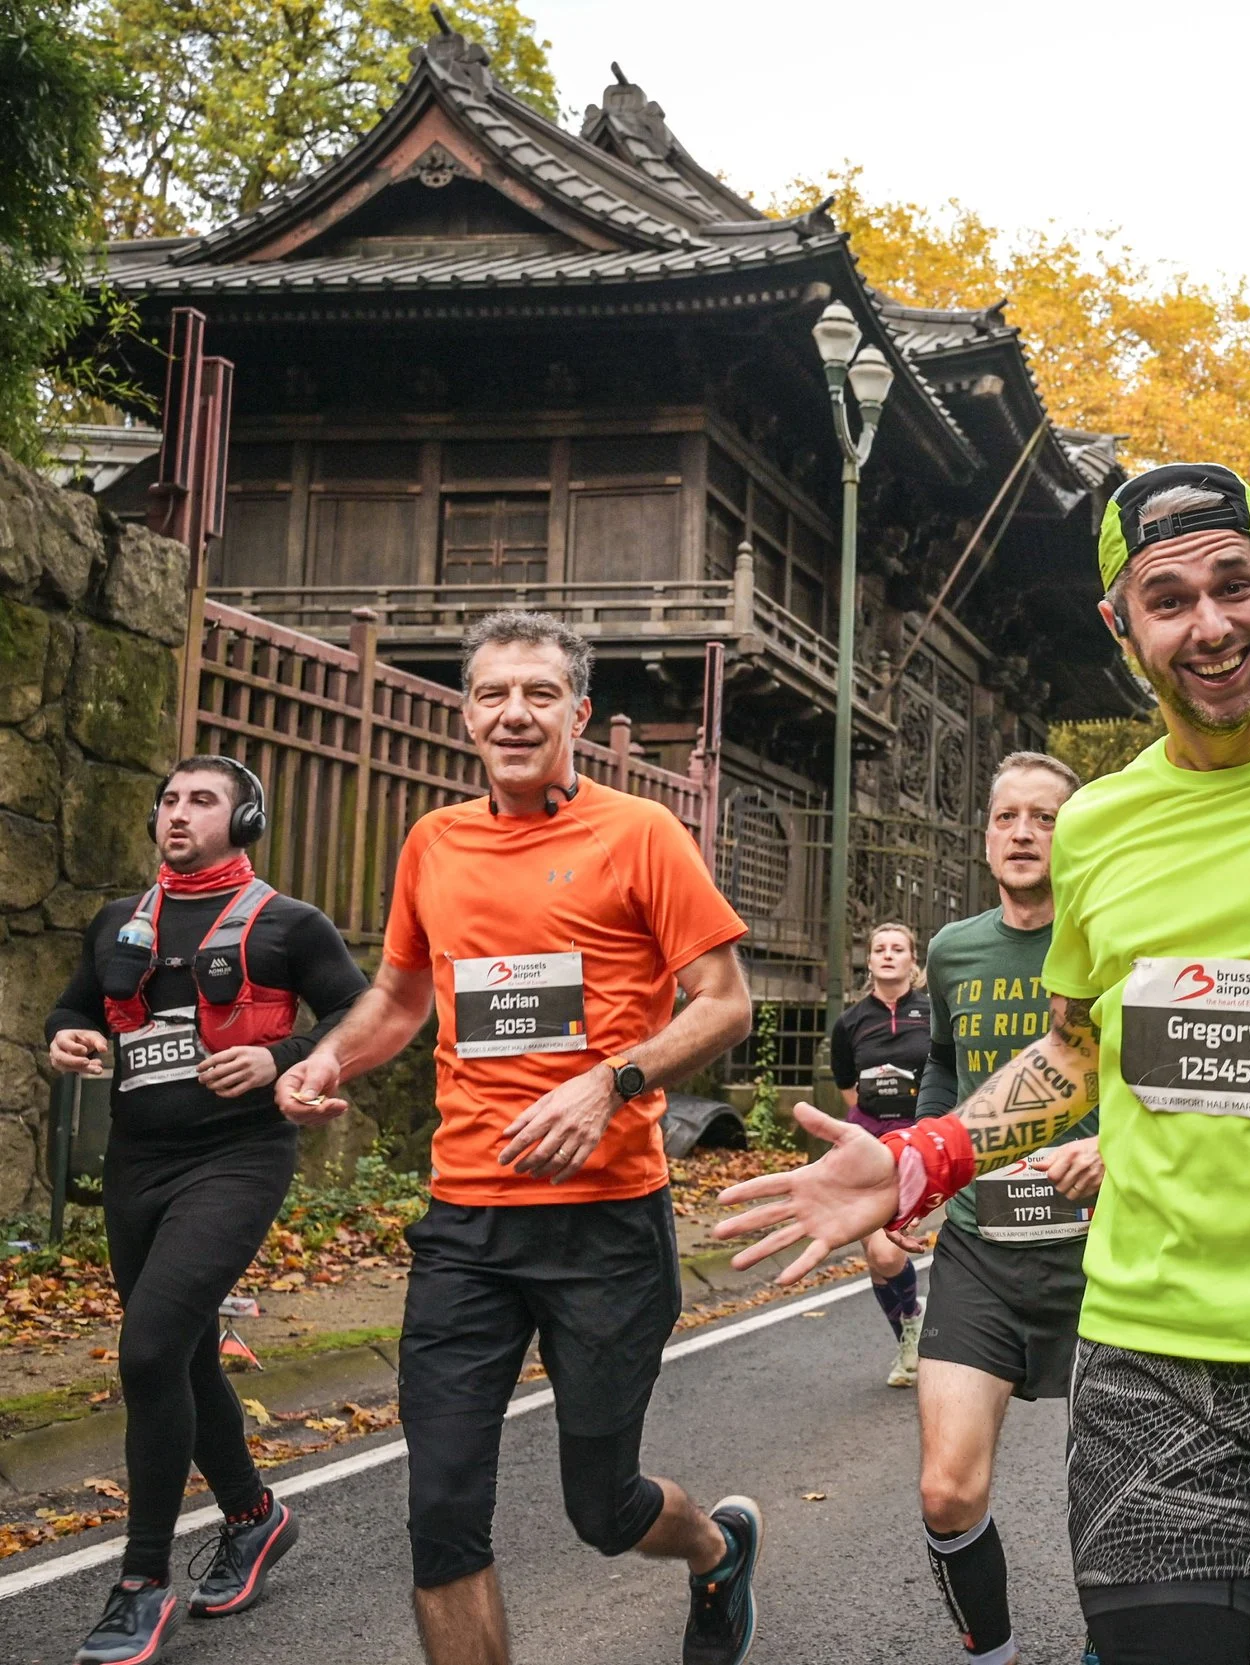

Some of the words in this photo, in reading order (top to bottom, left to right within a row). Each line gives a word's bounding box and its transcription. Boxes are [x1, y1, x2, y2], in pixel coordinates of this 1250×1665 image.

[512, 962, 547, 972] brussels
[512, 970, 541, 980] airport
[956, 979, 982, 1005] I'D
[489, 992, 540, 1011] Adrian
[495, 1017, 537, 1035] 5053
[958, 1013, 982, 1037] BE
[127, 1038, 195, 1071] 13565
[967, 1049, 998, 1073] MY
[1024, 1048, 1077, 1099] FOCUS
[1168, 1096, 1204, 1107] AIRPORT
[1206, 1099, 1230, 1110] HALF
[1007, 1183, 1054, 1199] Lucian
[1013, 1205, 1052, 1222] 11791
